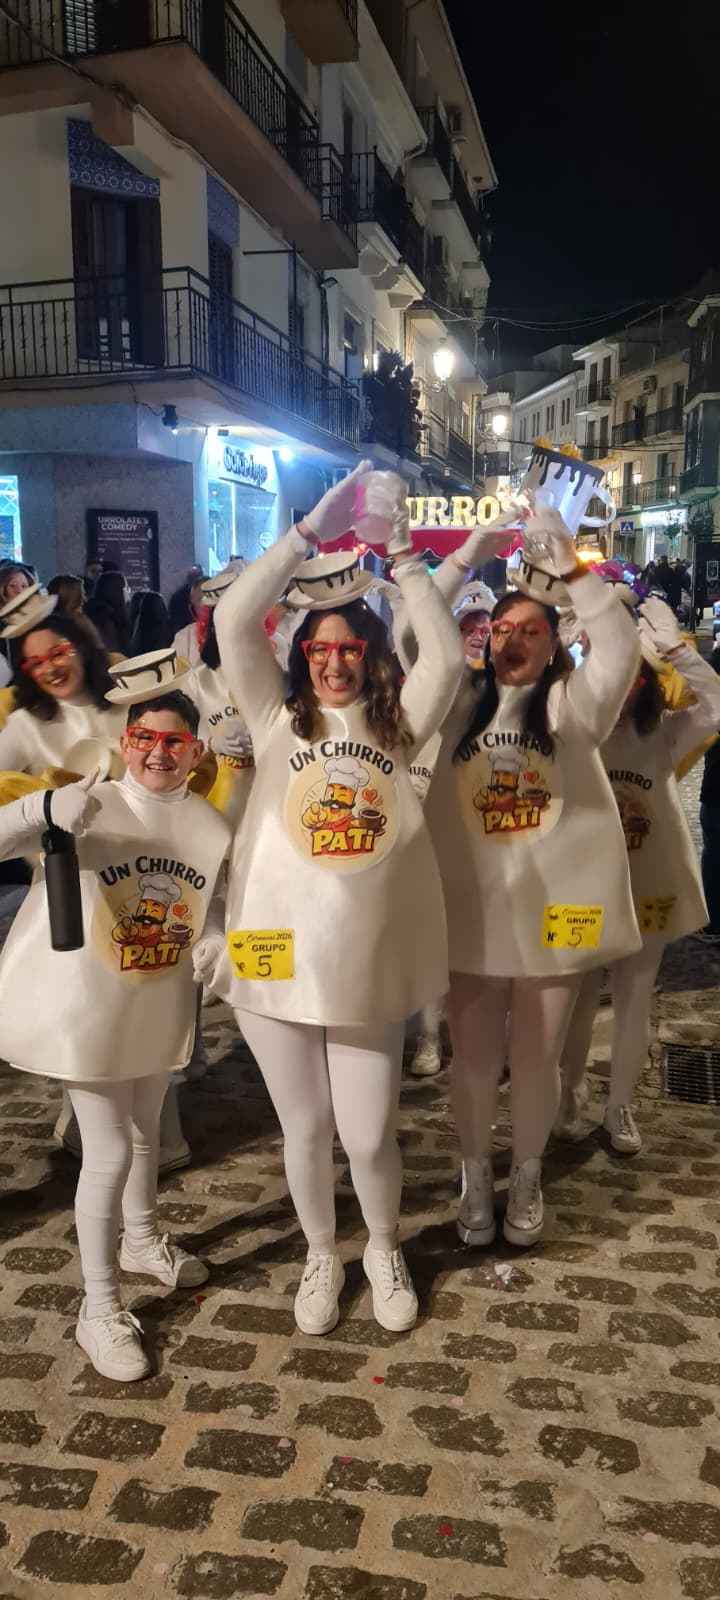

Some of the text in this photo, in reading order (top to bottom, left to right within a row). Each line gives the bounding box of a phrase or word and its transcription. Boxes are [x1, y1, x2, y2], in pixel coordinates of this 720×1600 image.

[101, 523, 138, 531] COMEDY
[208, 711, 224, 726] UN
[289, 741, 394, 775] UN CHURRO
[99, 855, 206, 890] UN CHURRO
[567, 926, 583, 947] 5
[251, 943, 287, 953] GRUPO
[256, 954, 273, 977] 5
